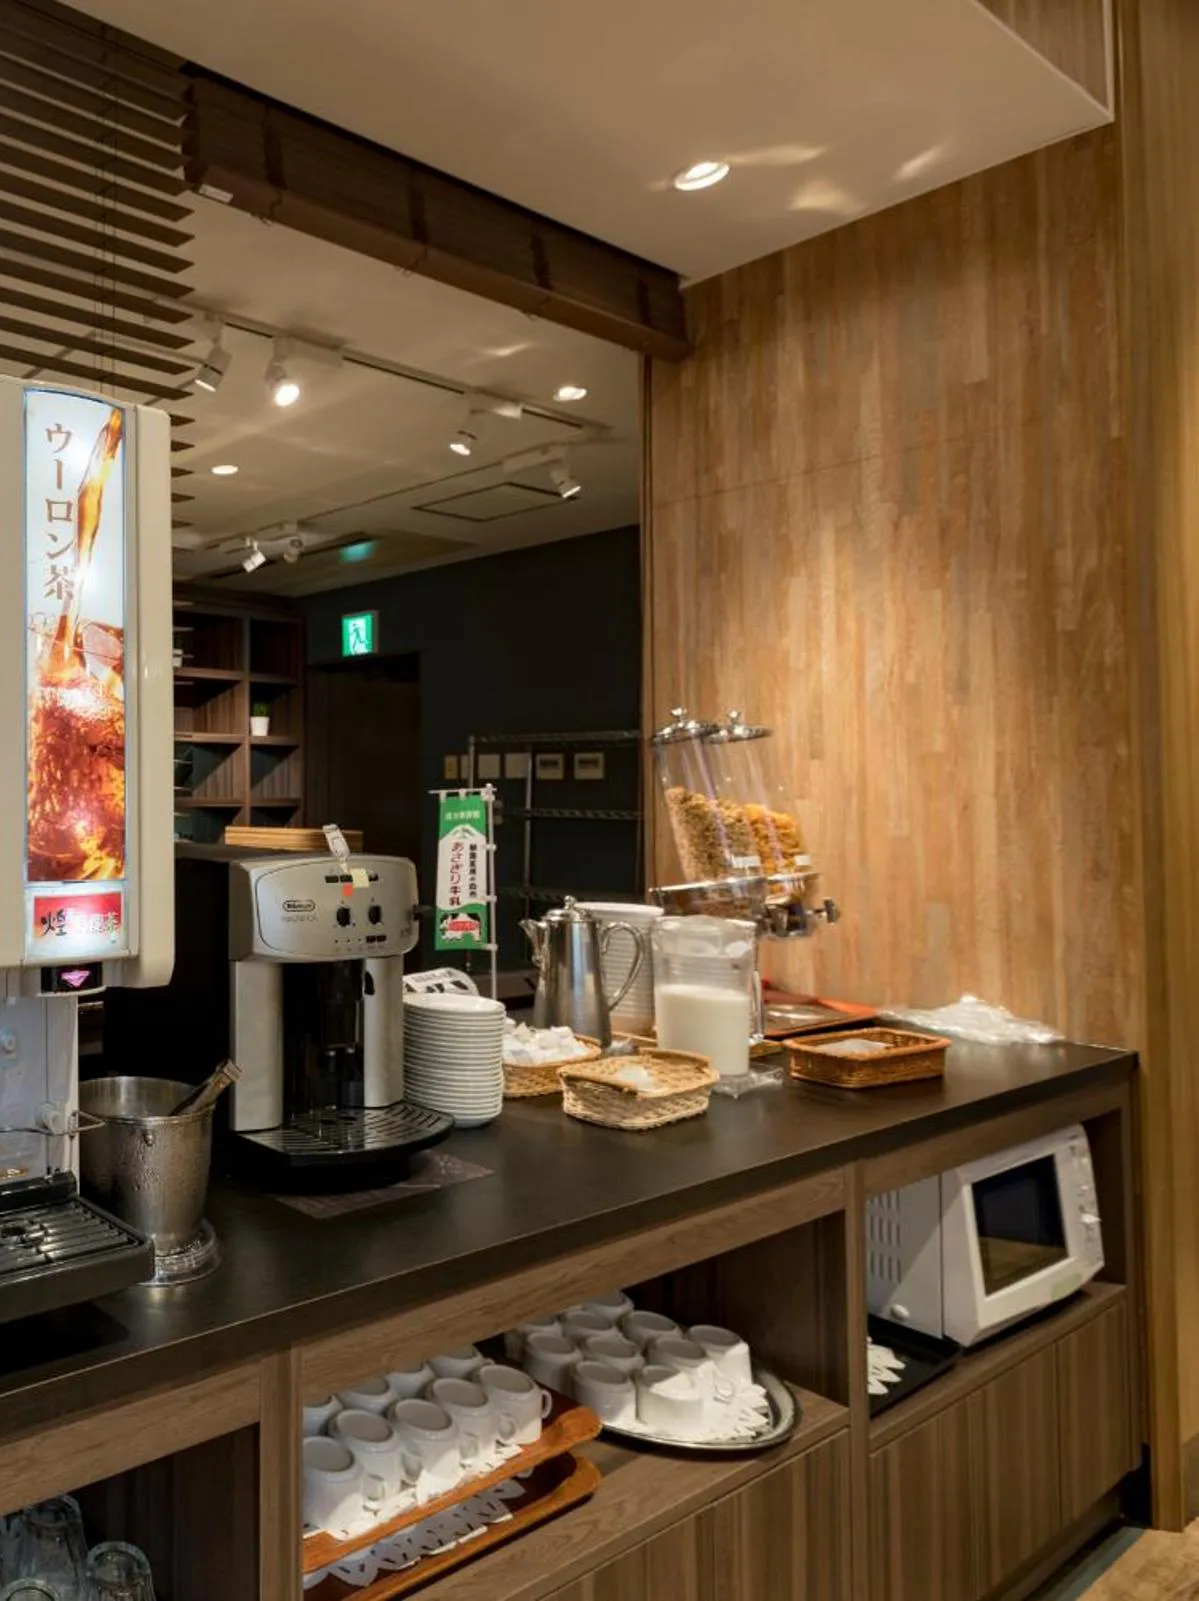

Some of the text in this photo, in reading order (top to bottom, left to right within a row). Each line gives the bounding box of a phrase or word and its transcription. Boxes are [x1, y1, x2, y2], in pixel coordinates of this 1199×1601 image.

[43, 422, 75, 602] ウーロン茶
